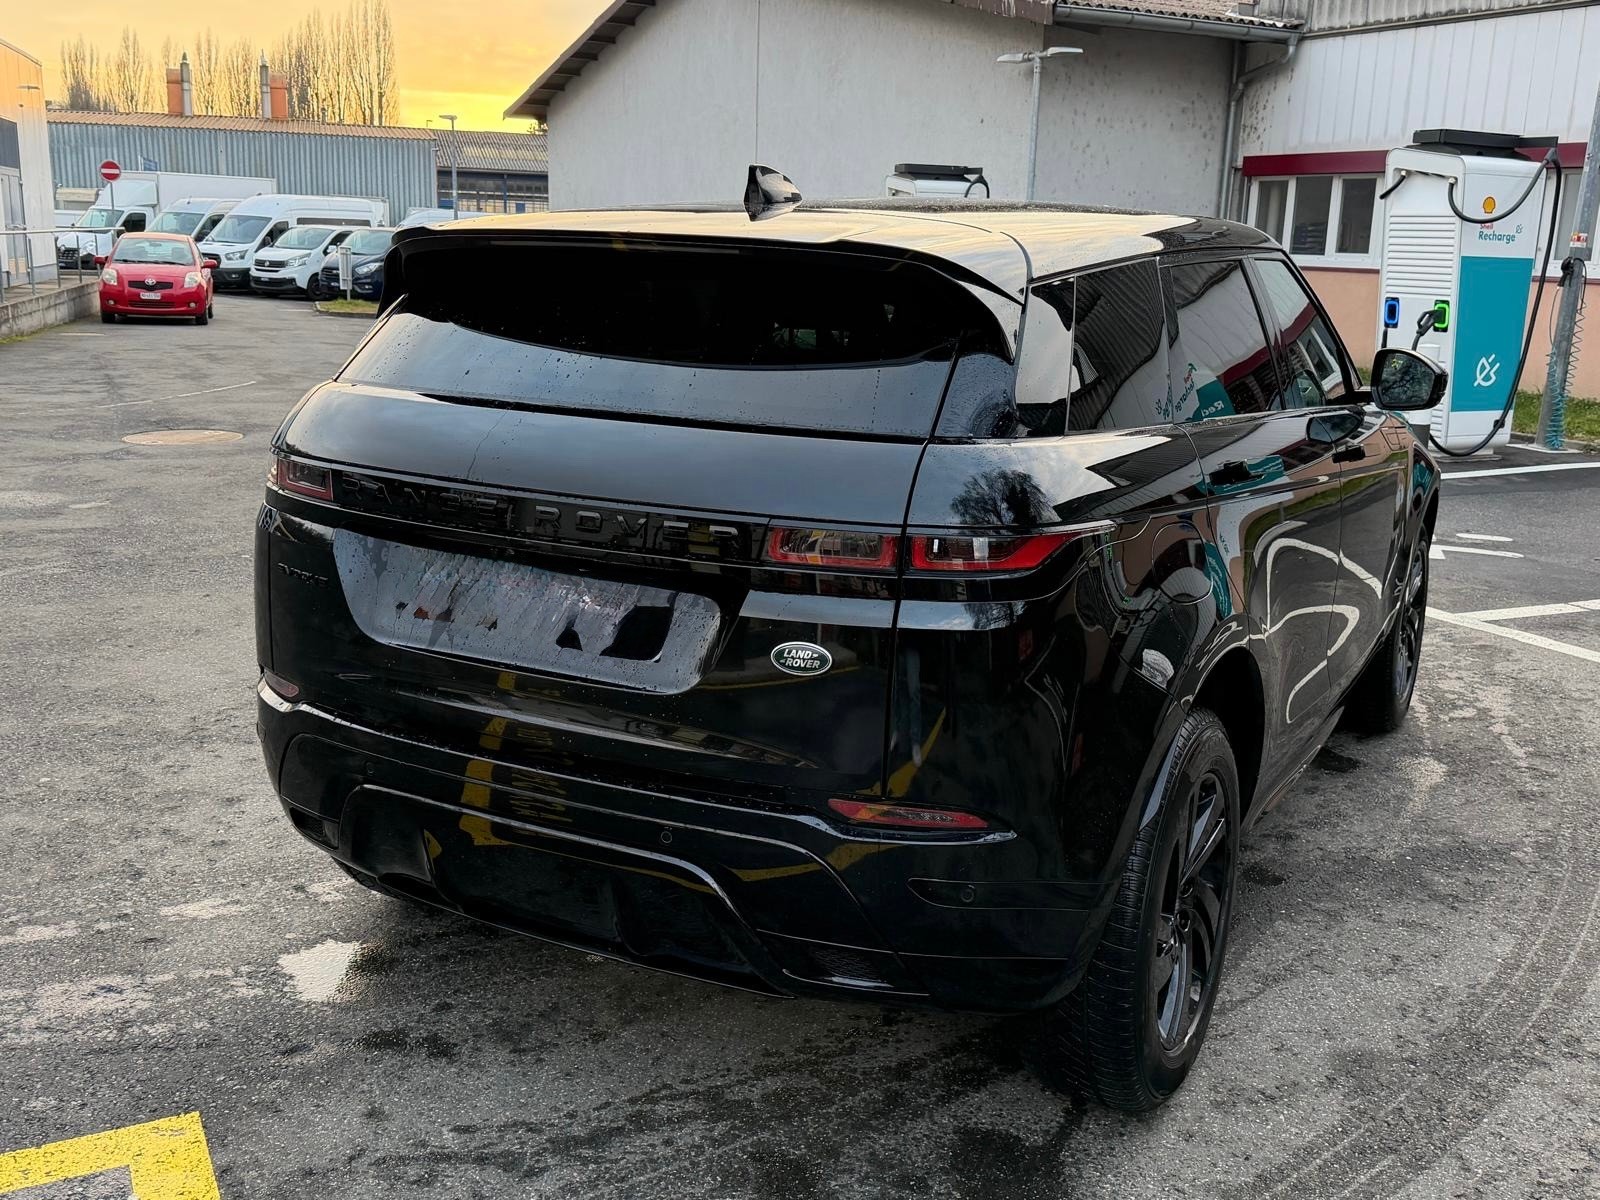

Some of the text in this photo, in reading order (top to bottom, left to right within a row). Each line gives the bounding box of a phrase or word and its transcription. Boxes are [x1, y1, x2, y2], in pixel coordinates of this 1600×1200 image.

[1478, 231, 1516, 244] Recharge
[535, 505, 740, 548] ROVER
[785, 657, 821, 669] ROVER
